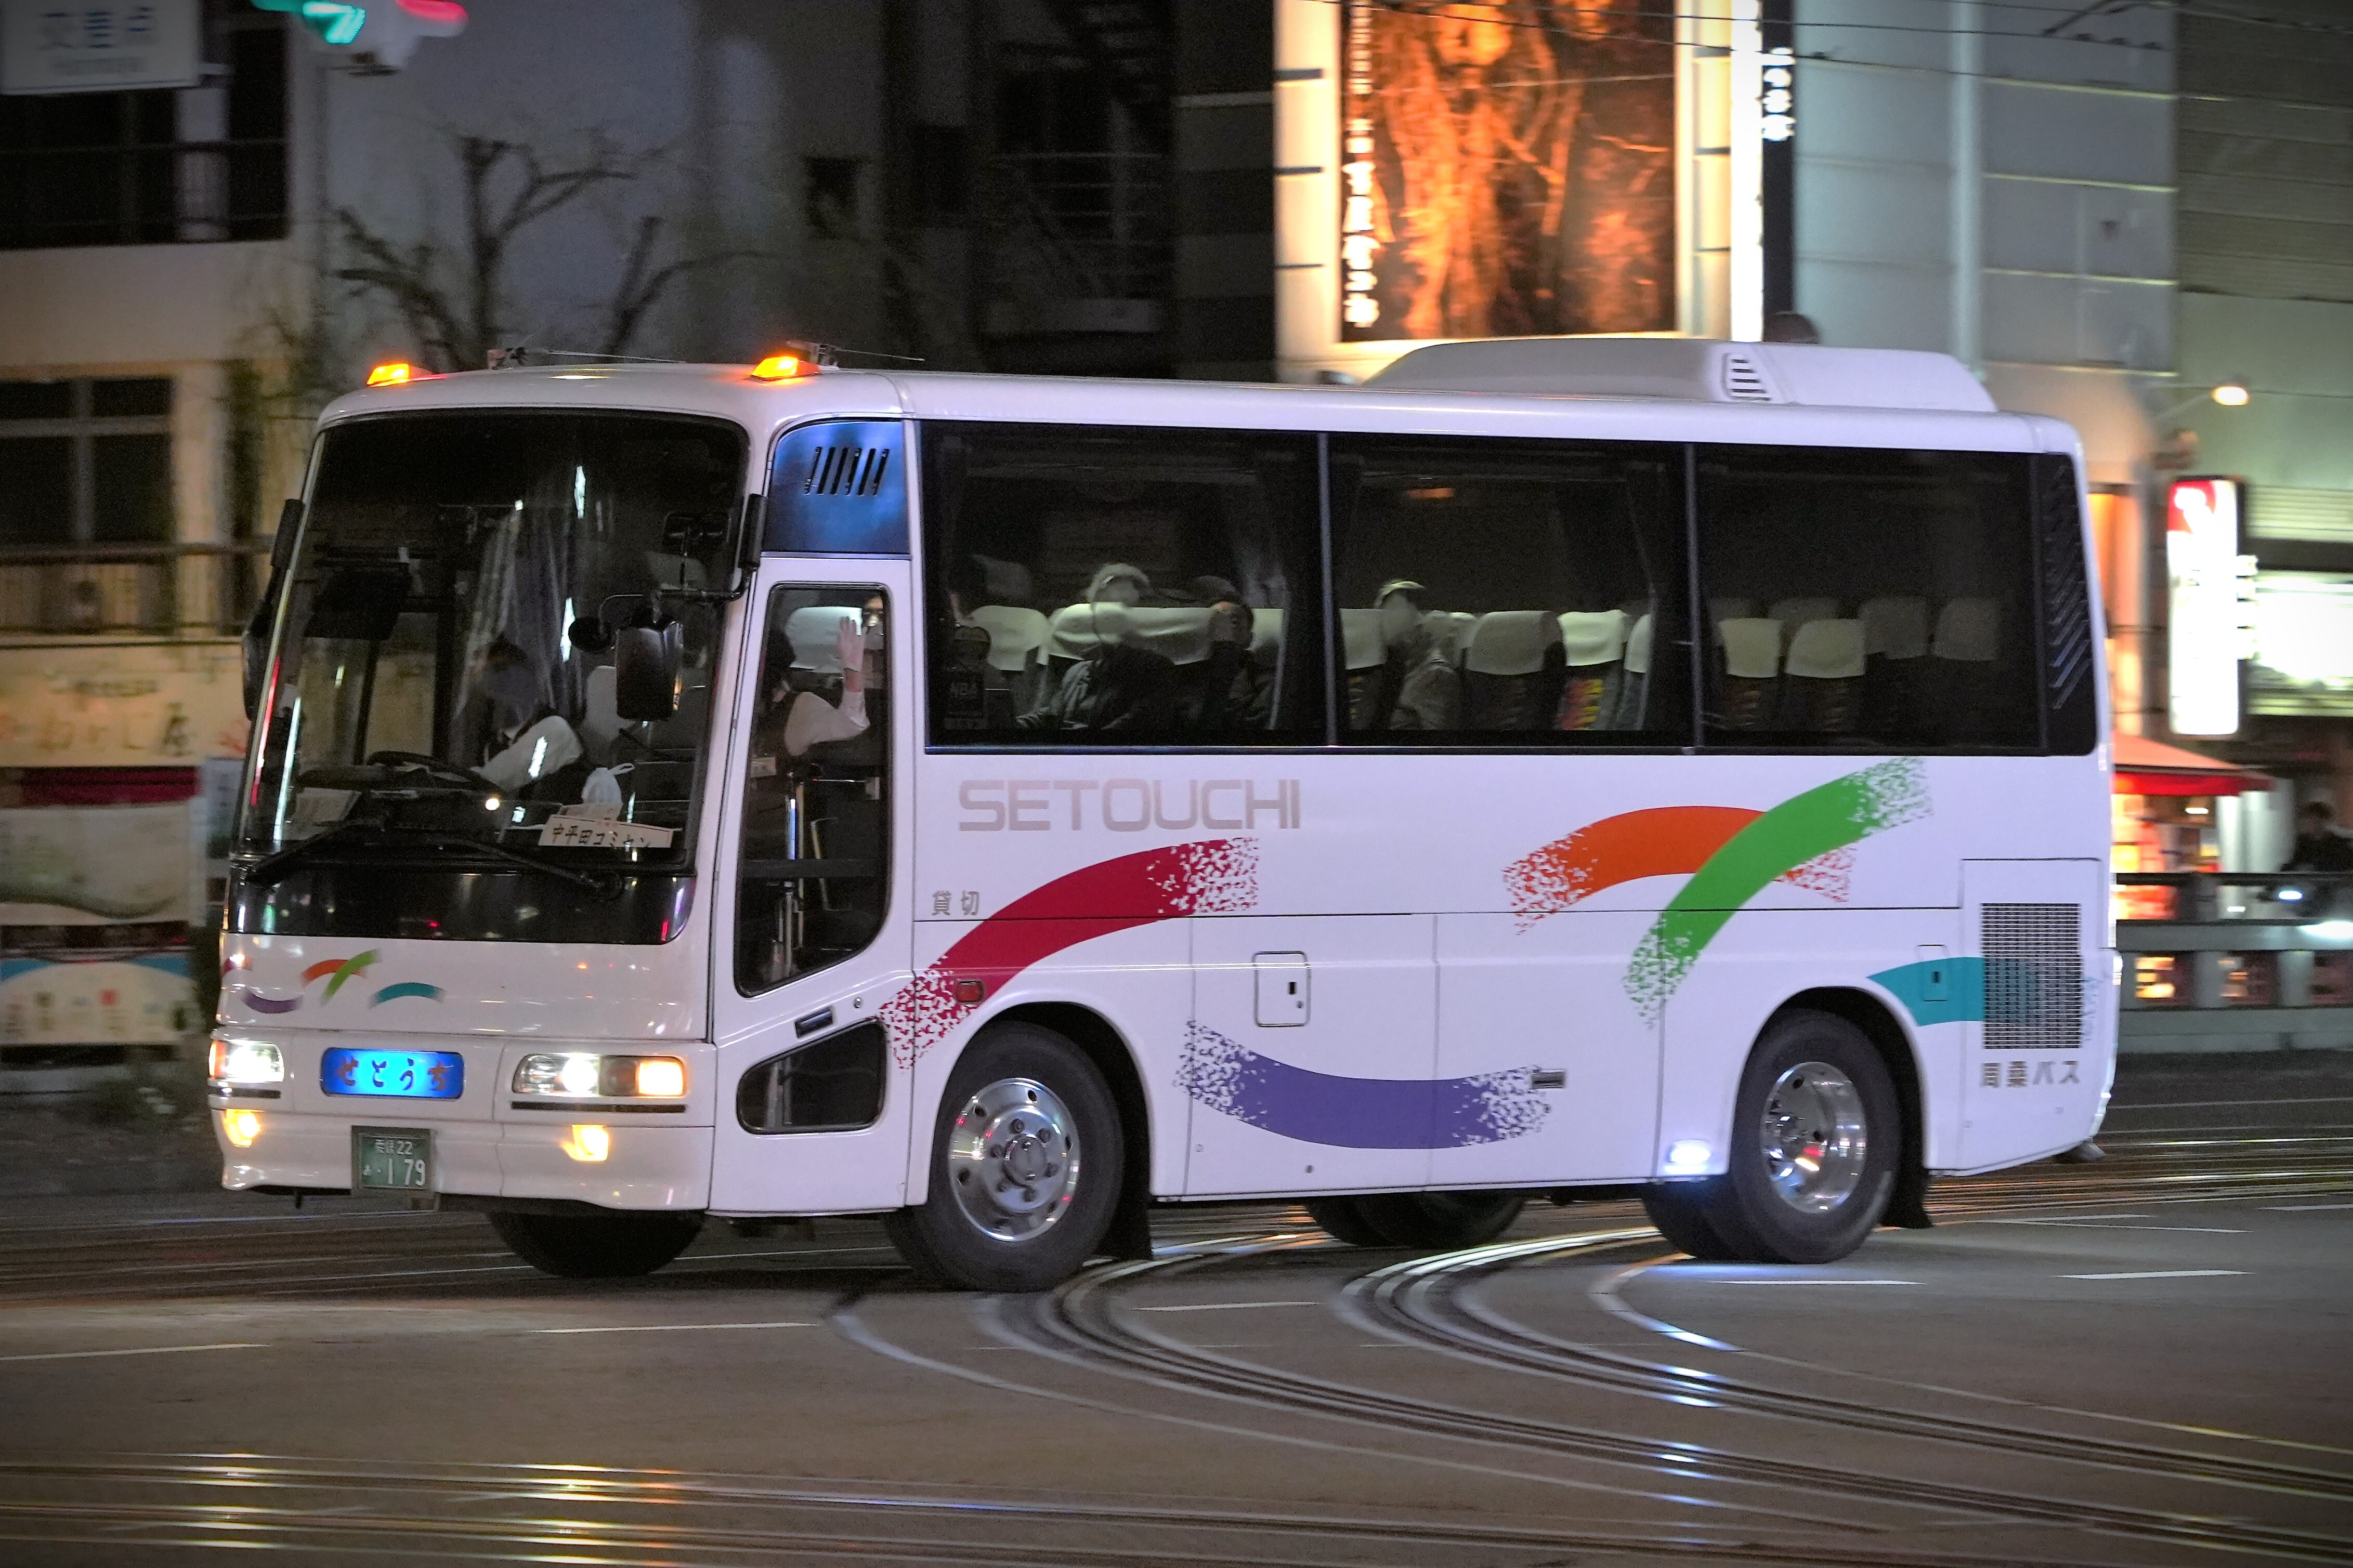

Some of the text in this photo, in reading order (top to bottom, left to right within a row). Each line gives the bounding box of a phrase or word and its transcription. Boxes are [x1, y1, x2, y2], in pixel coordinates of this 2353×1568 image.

[958, 778, 1301, 832] SETOUCHI
[932, 890, 980, 916] 貸切
[337, 1056, 448, 1091] せとうち
